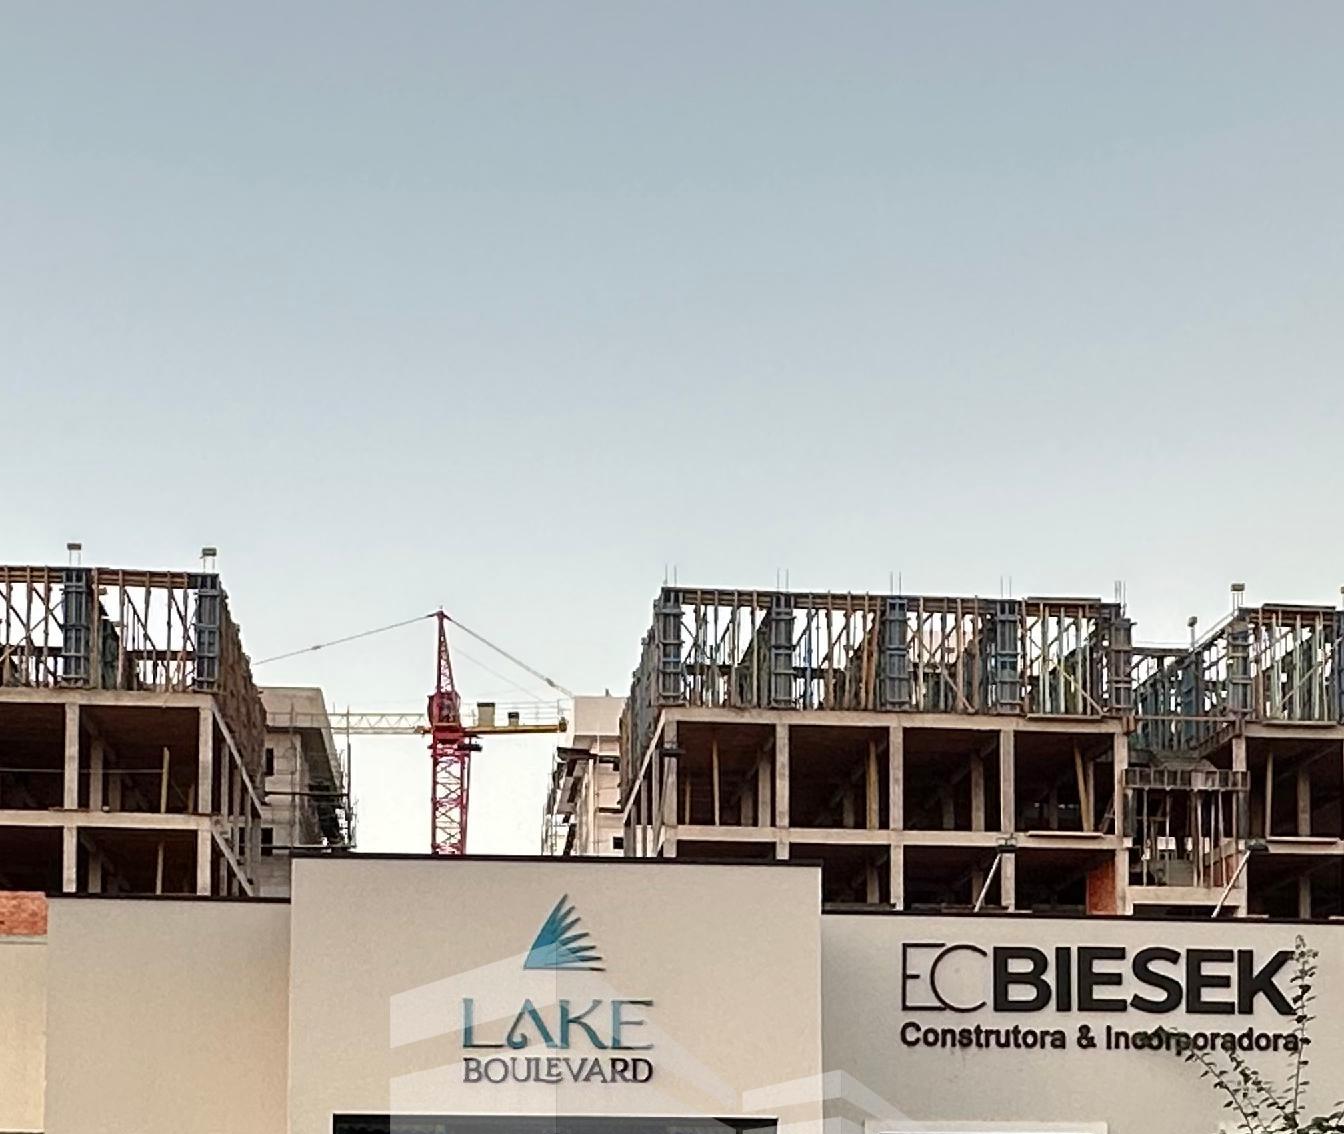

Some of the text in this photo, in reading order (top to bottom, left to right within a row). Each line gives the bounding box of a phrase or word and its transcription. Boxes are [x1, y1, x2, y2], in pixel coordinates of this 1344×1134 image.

[462, 998, 655, 1050] LAKE
[900, 1021, 1300, 1056] Construtora & Incorporadora
[463, 1057, 655, 1084] BOULEVARD
